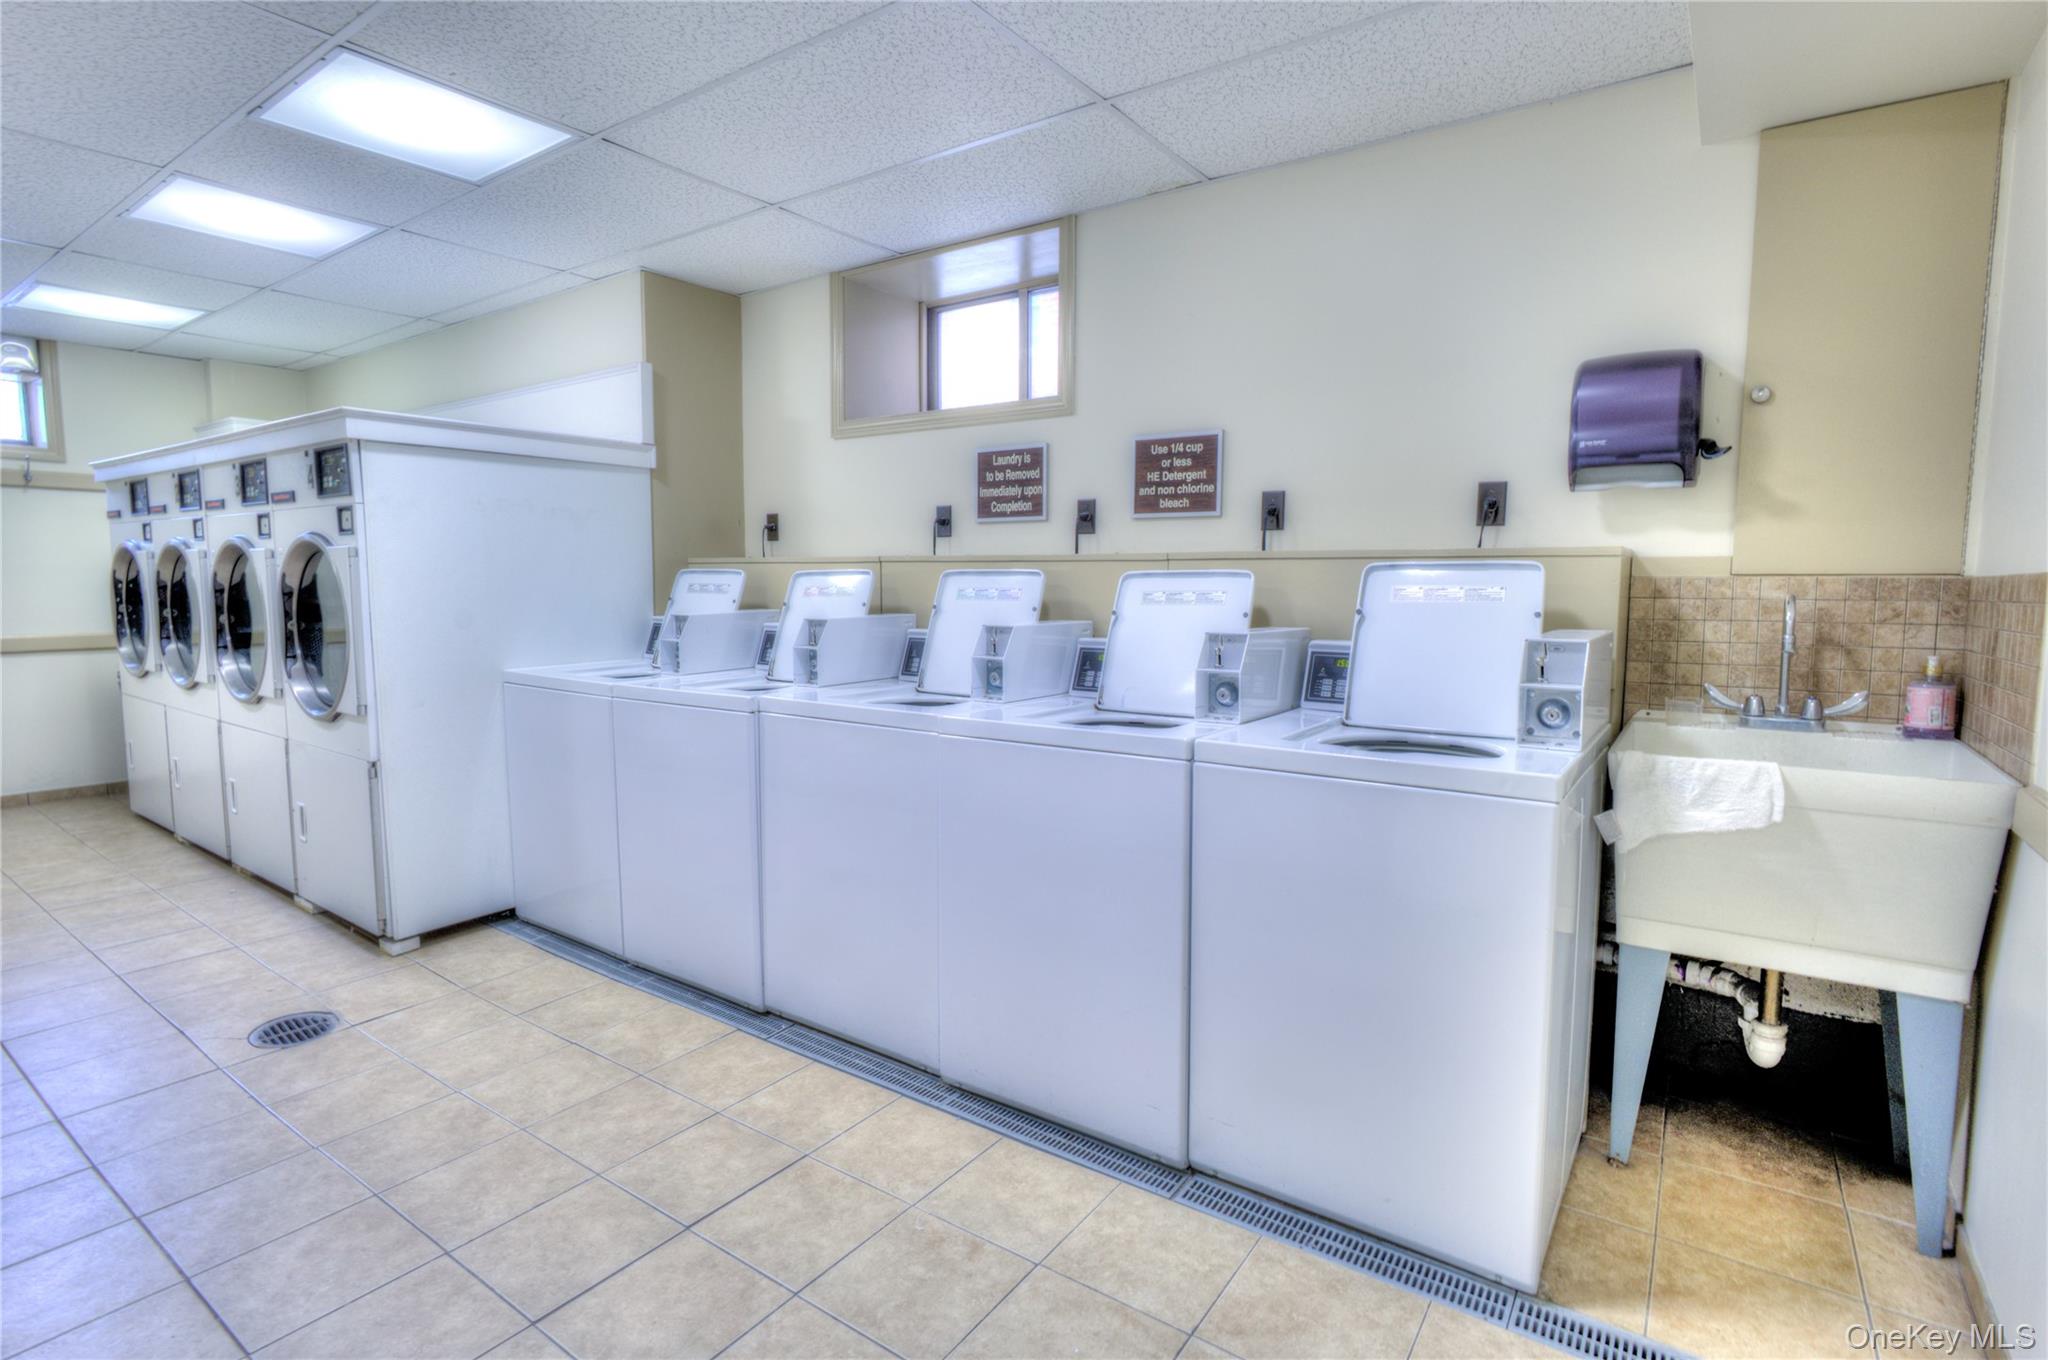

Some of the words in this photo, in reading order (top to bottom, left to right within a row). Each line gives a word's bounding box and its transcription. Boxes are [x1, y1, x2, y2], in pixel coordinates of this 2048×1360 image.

[1151, 444, 1169, 455] Use
[1170, 442, 1184, 453] 1/4
[1185, 442, 1204, 454] cup
[992, 453, 1023, 467] Laundry
[1023, 452, 1031, 464] is
[1161, 459, 1172, 468] or
[1173, 457, 1192, 467] less
[986, 471, 994, 482] to
[995, 470, 1005, 481] be
[1005, 466, 1040, 480] Removed
[1147, 471, 1160, 482] HE
[1162, 470, 1207, 482] Detergent
[1023, 485, 1043, 498] upon
[1139, 485, 1156, 496] and
[1157, 486, 1175, 495] non
[1176, 483, 1215, 494] chlorine
[990, 500, 1033, 514] Completion
[1159, 497, 1190, 509] bleach
